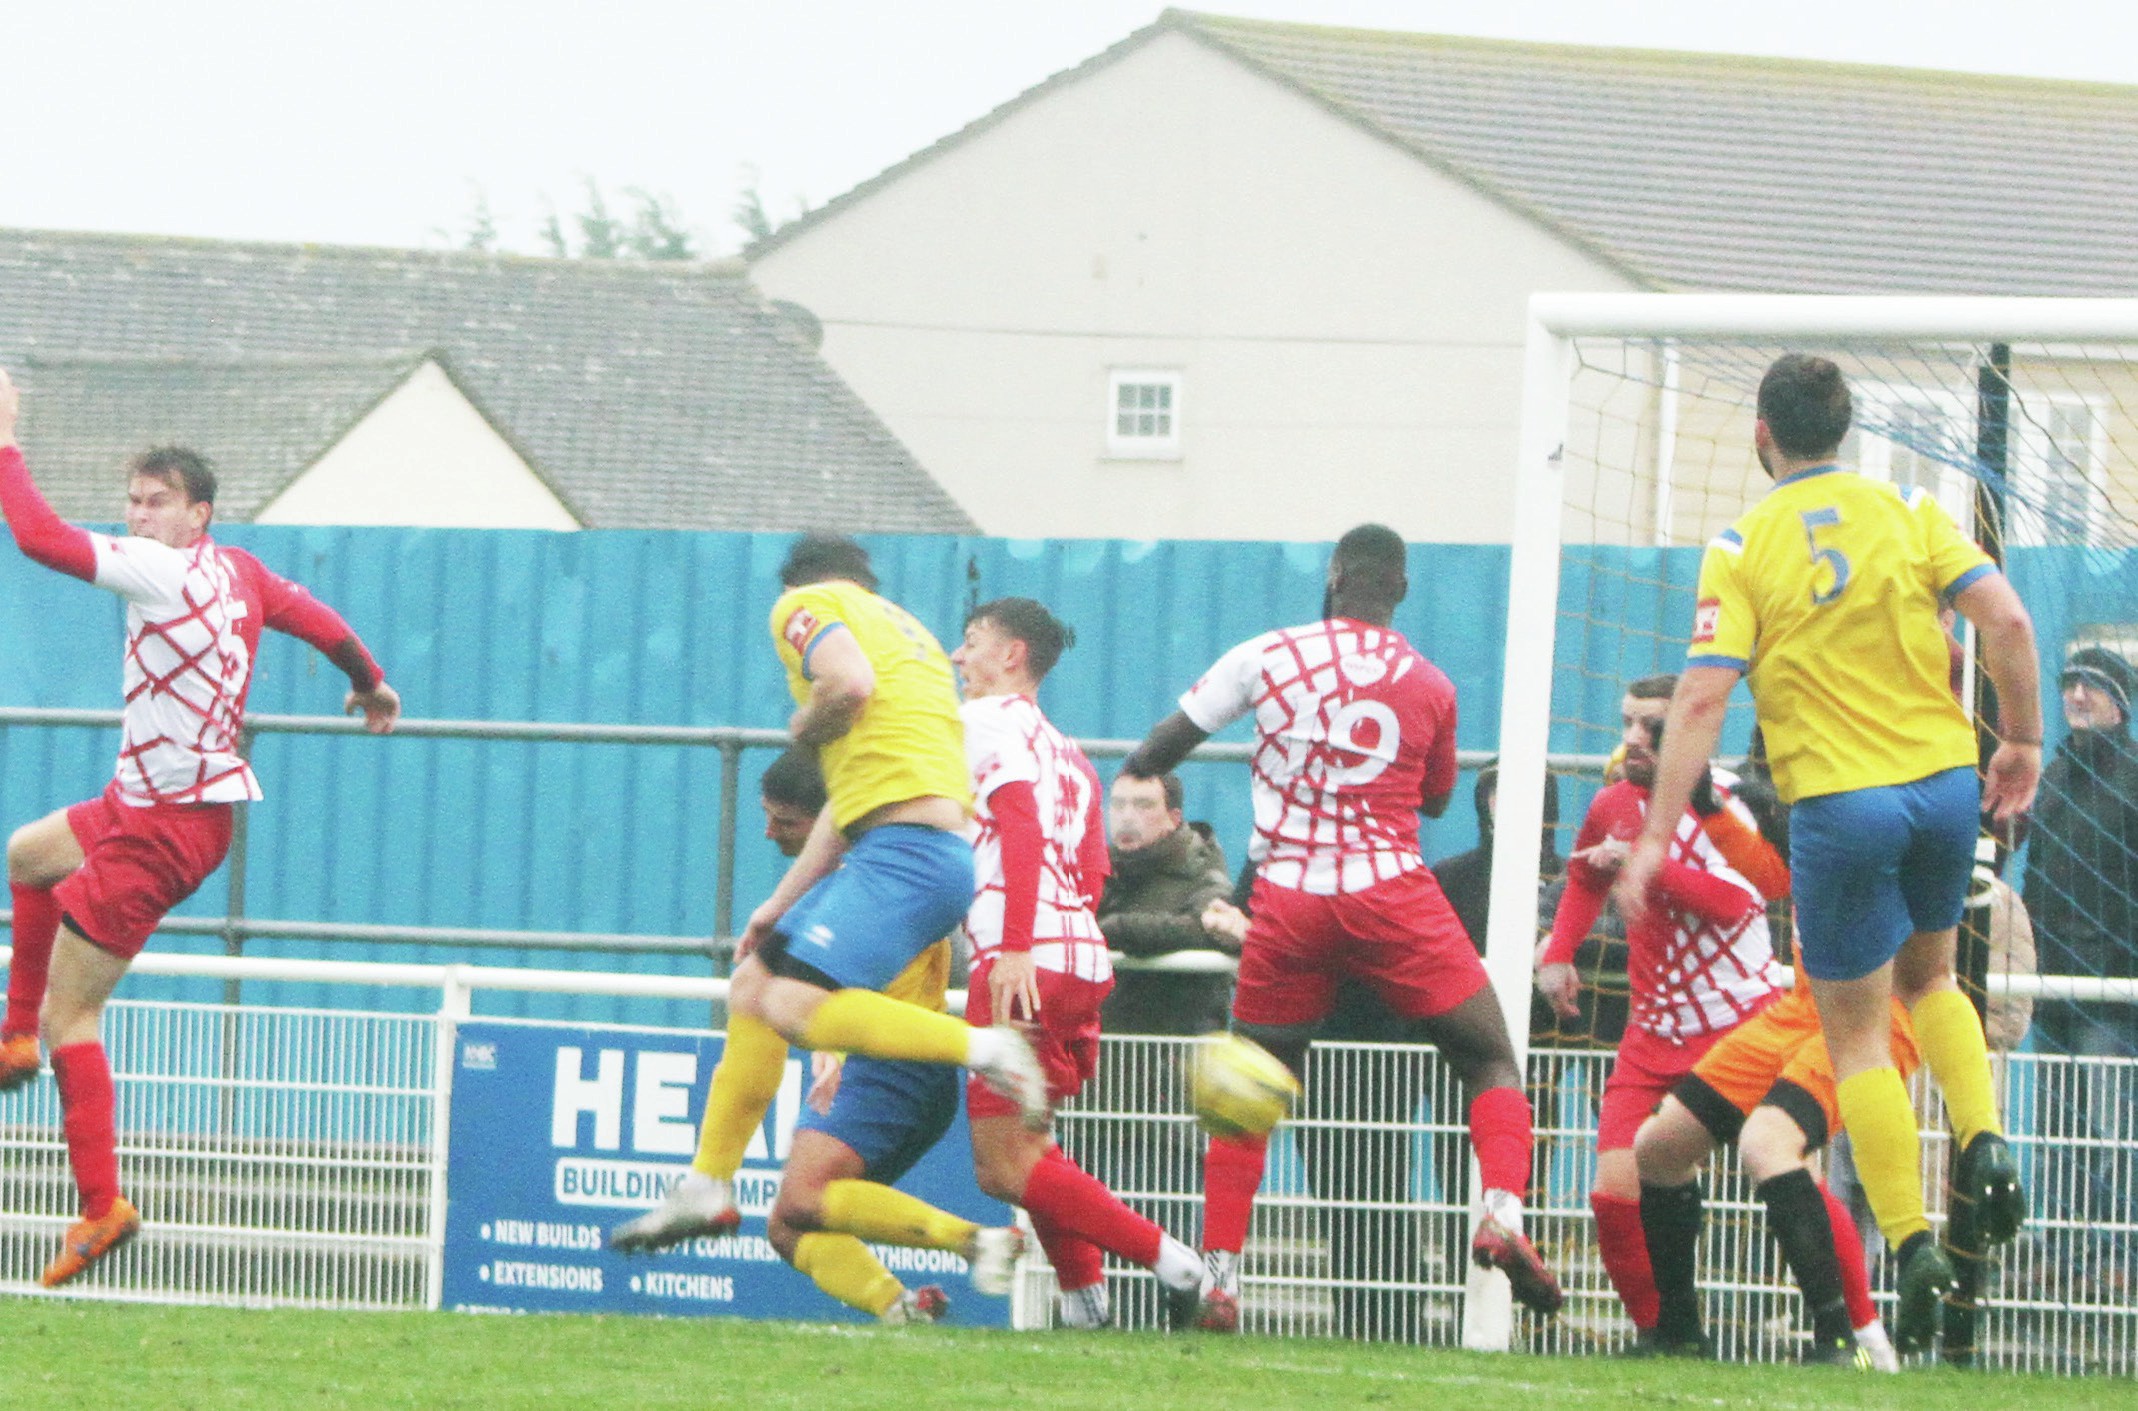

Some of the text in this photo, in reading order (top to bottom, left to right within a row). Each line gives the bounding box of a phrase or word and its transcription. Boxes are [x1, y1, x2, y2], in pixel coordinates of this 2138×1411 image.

[1799, 507, 1851, 606] 5
[1278, 691, 1401, 788] 19
[552, 1047, 802, 1160] HE
[495, 1219, 601, 1250] NEW BUILDS
[694, 1235, 781, 1263] CONVERS
[868, 1244, 968, 1274] THROOMS
[494, 1261, 603, 1292] EXTENSIONS
[645, 1271, 733, 1302] KITCHENS
